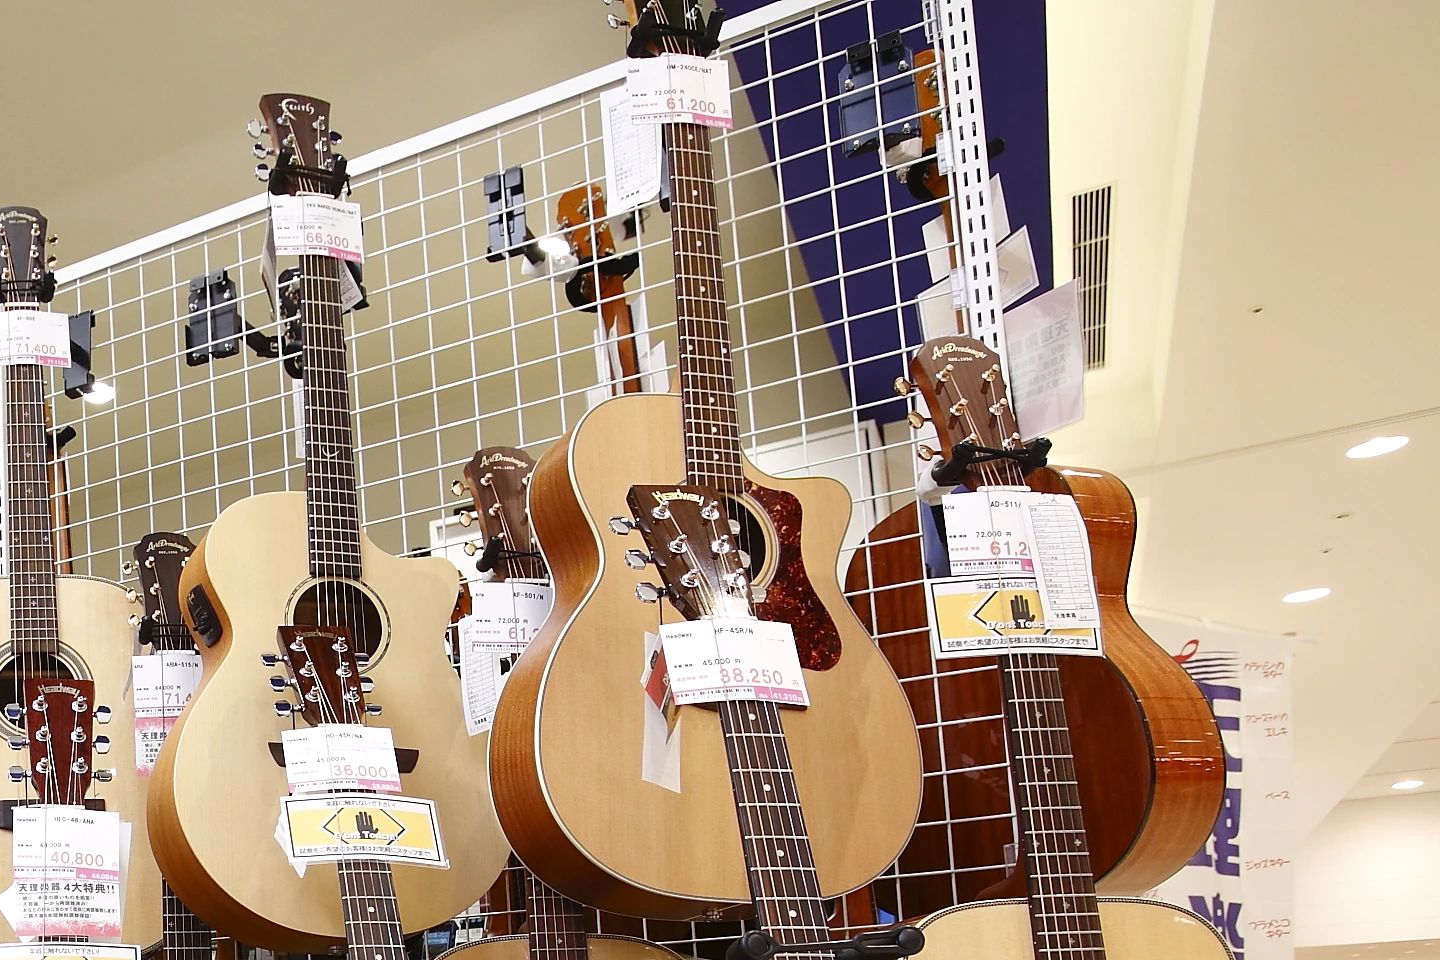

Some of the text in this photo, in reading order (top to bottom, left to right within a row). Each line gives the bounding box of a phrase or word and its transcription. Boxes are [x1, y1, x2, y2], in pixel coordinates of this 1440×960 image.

[666, 97, 716, 114] 61,200
[306, 232, 349, 249] 66,300
[16, 343, 57, 355] 71,400
[652, 489, 705, 506] Headway
[990, 540, 1031, 557] 61,2
[720, 668, 783, 685] 38,250
[38, 683, 80, 699] Headway
[1264, 727, 1288, 737] エレキ
[334, 764, 388, 778] 36,000
[50, 851, 104, 866] 40,800
